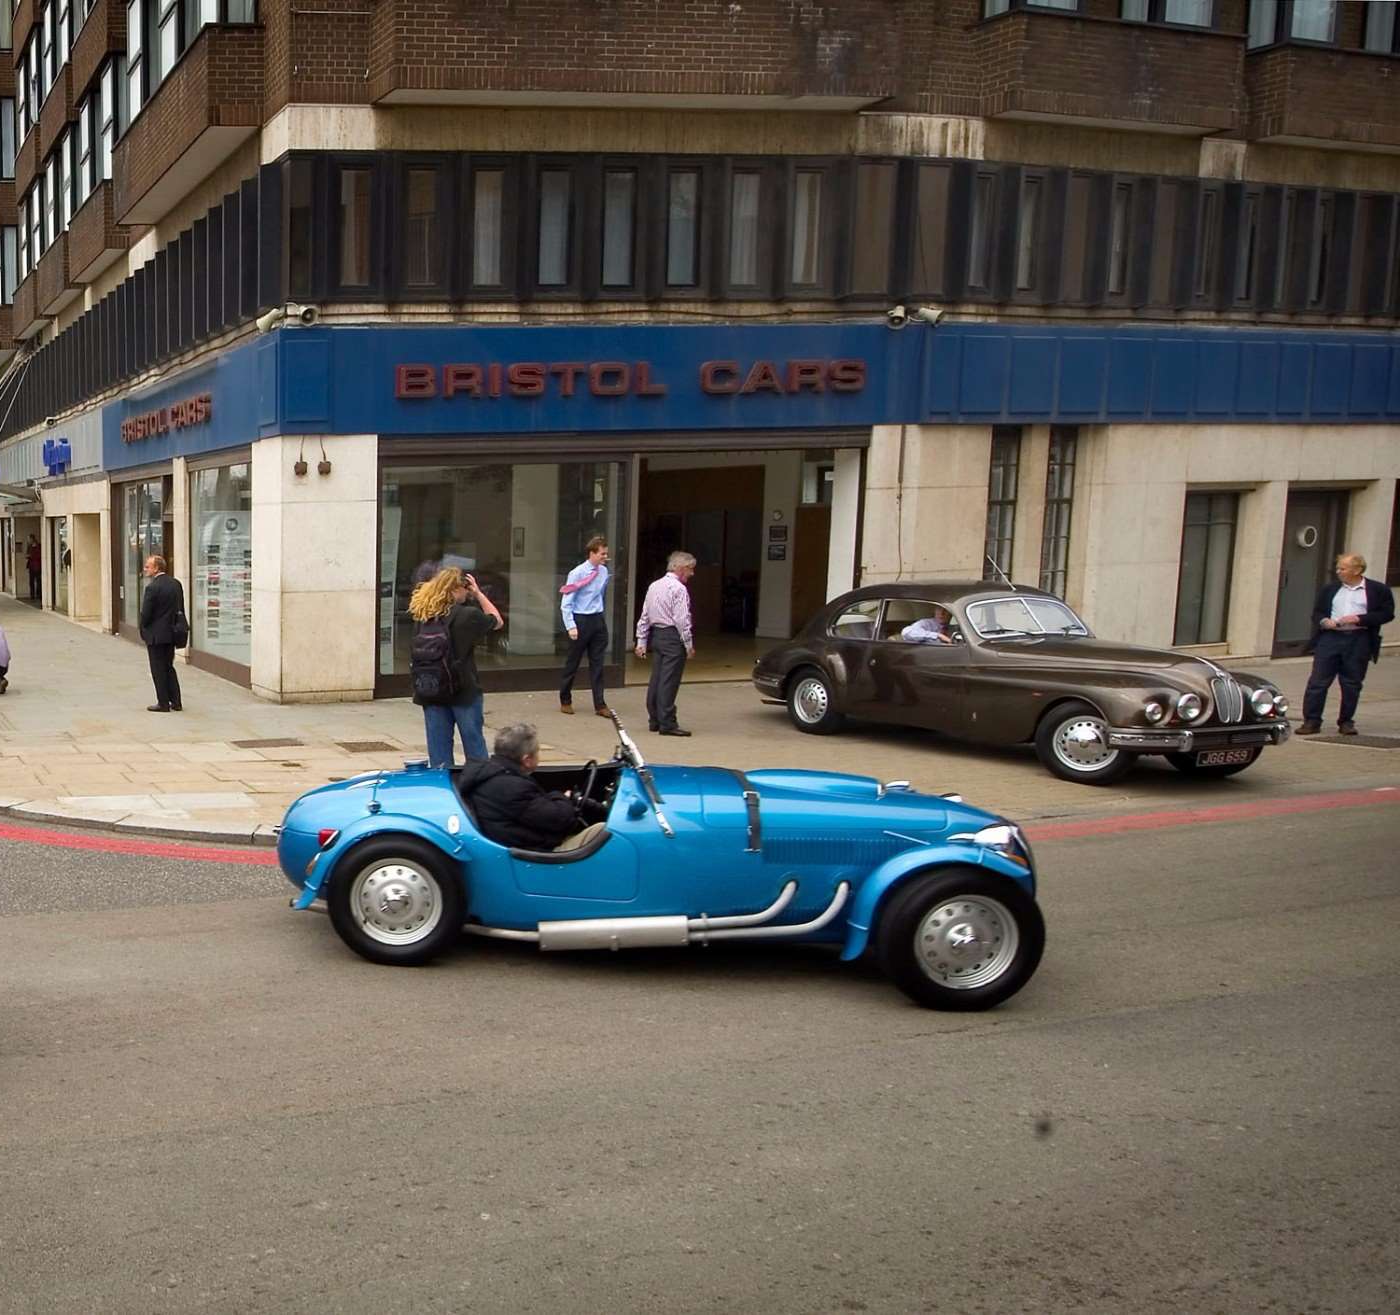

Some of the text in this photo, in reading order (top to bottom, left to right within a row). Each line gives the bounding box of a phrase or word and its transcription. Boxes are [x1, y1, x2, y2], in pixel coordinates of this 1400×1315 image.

[395, 359, 866, 398] BRISTOL CARS
[122, 392, 212, 444] BRISTOL CARS
